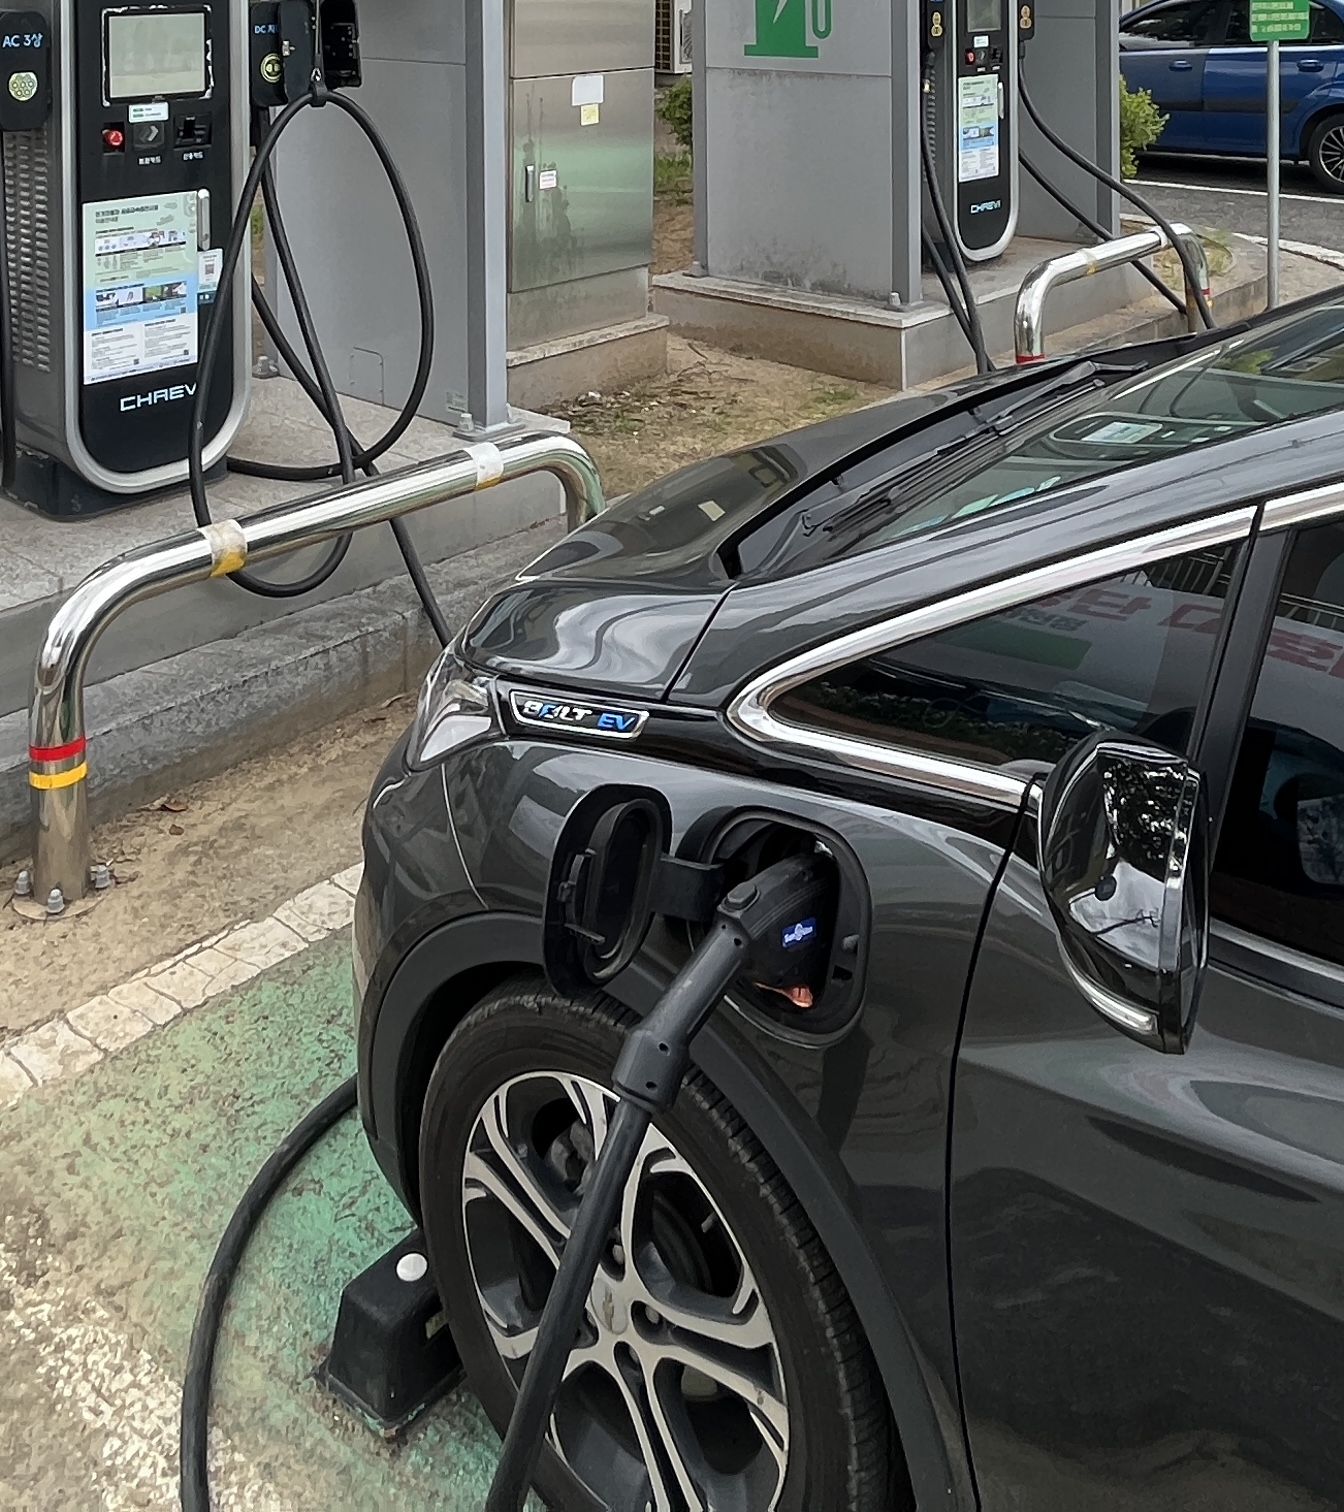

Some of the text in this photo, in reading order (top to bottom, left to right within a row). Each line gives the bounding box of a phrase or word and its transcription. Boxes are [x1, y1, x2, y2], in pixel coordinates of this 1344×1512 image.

[2, 32, 44, 48] AC 3상
[254, 25, 266, 34] DC
[120, 382, 197, 412] CHAEV
[523, 700, 636, 731] BOLT EV
